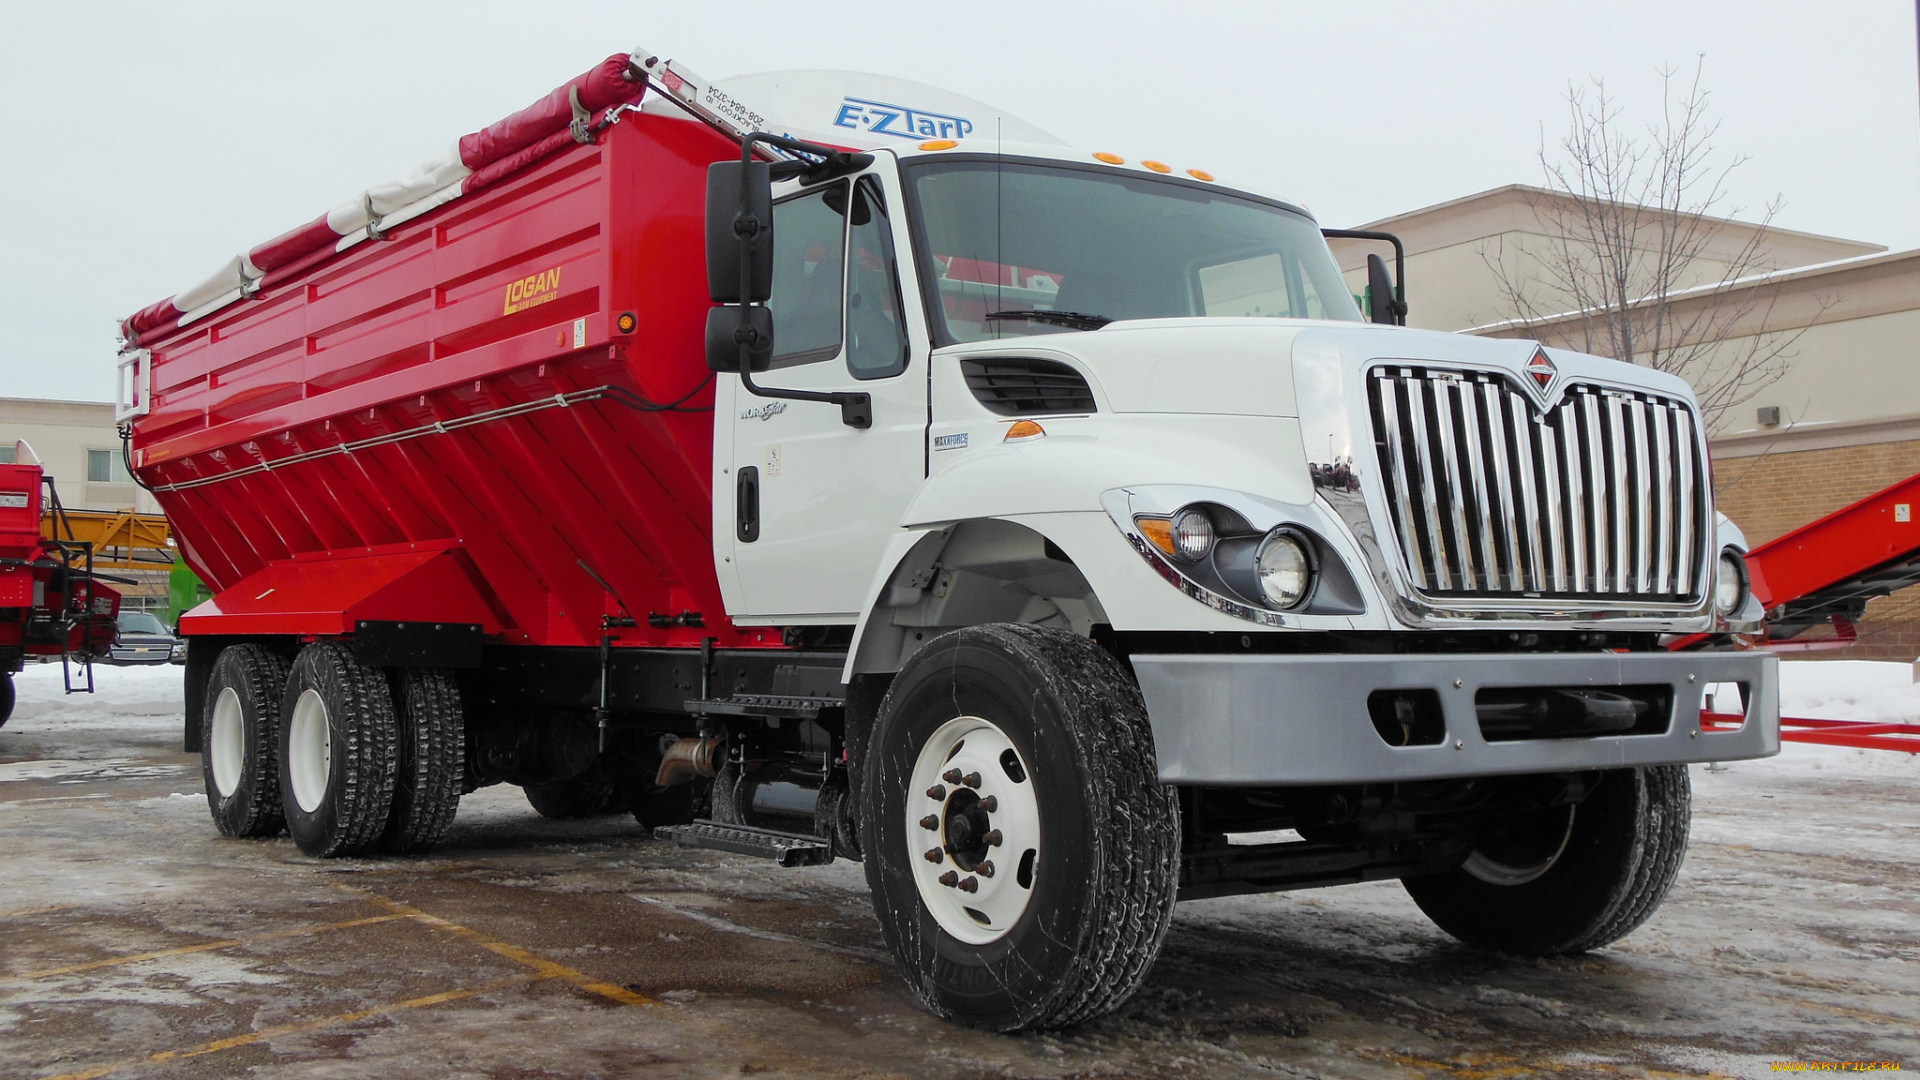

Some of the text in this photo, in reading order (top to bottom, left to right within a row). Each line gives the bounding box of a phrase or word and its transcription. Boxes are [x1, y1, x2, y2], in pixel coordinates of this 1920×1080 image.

[705, 96, 714, 104] ID
[708, 85, 765, 127] 208-684-3734
[504, 266, 561, 316] LOGAN
